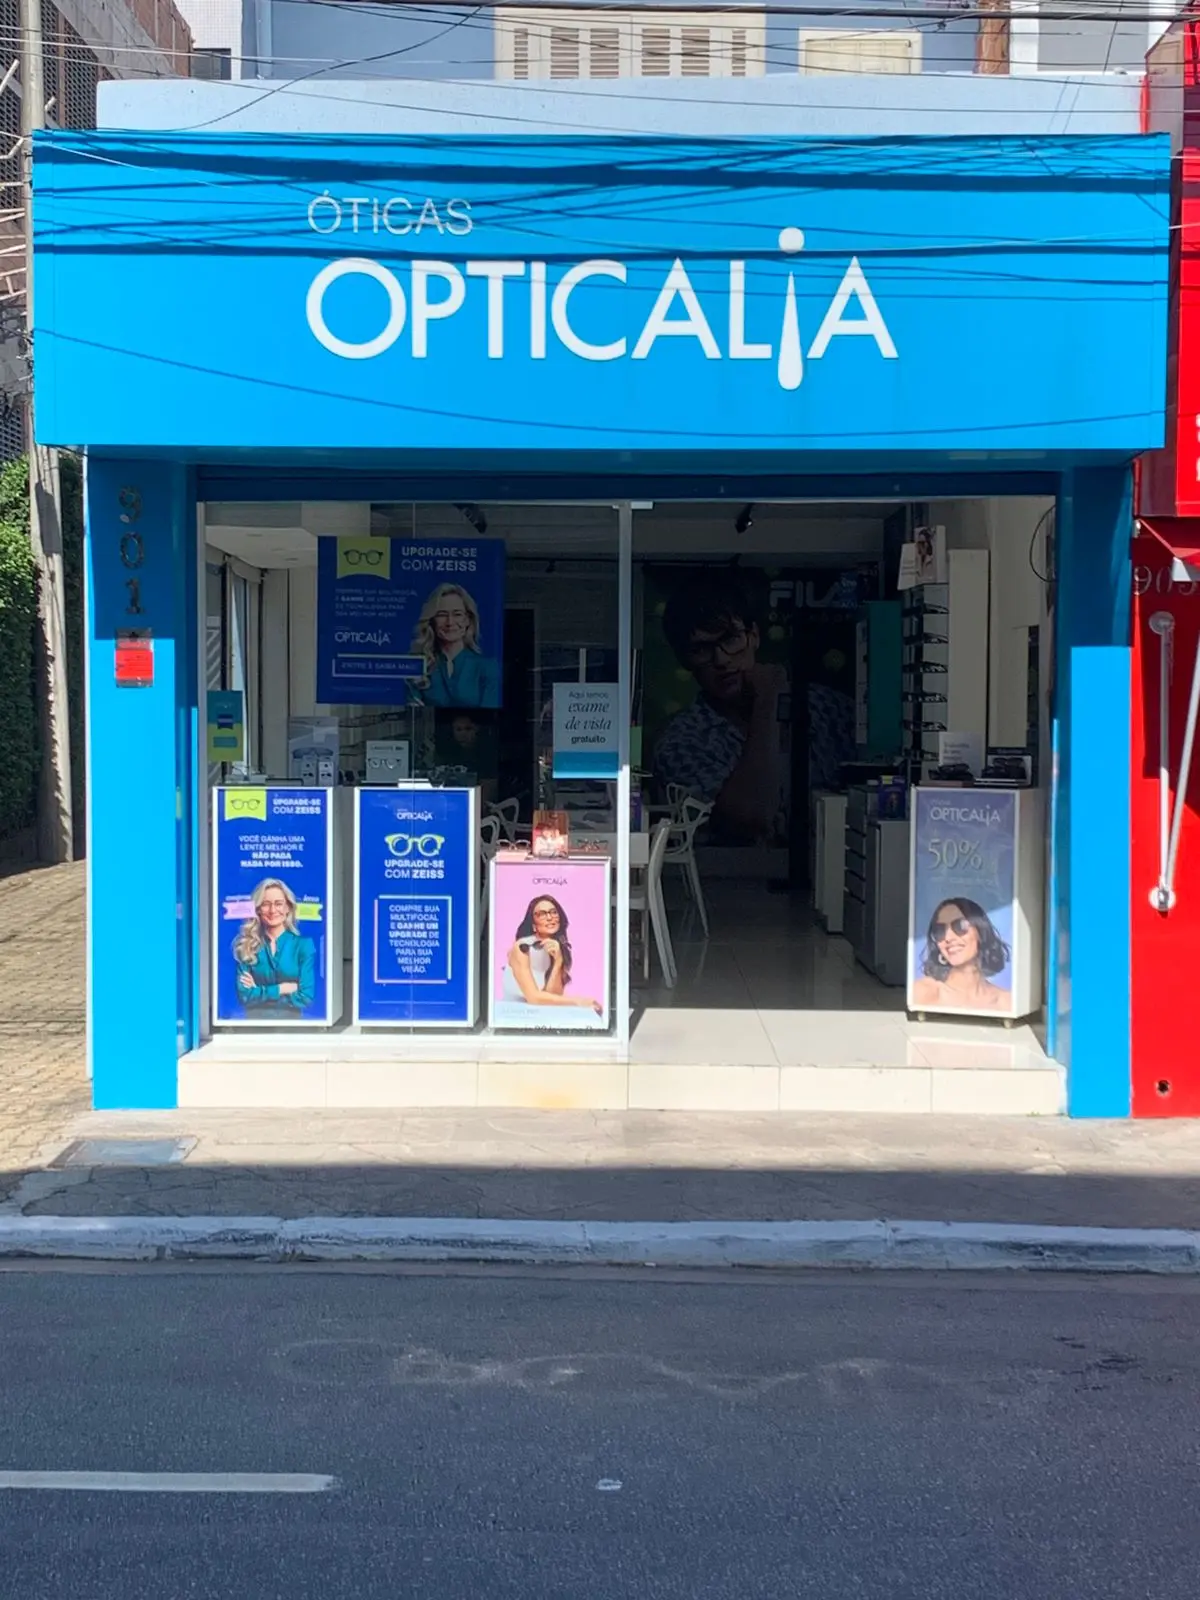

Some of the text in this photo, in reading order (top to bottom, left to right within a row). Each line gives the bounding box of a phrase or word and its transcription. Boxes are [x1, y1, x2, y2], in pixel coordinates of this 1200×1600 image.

[307, 190, 473, 236] ÓTICAS
[118, 485, 144, 615] 901
[401, 546, 478, 558] UPGRADE-SE
[401, 559, 477, 572] COM ZEISS
[568, 702, 610, 713] exame
[565, 716, 612, 731] de vista
[571, 735, 606, 745] gratuito
[272, 798, 321, 806] UPGRADE-SE
[273, 806, 321, 814] COM ZEISS
[239, 834, 305, 843] VOCÊ GANHA UMA
[239, 843, 264, 851] LENTE
[265, 843, 298, 851] MELHOR
[252, 851, 269, 859] NÃO
[927, 838, 984, 870] 50%
[384, 859, 445, 868] UPGRADE-SE
[385, 869, 445, 879] COM ZEISS
[389, 904, 440, 913] COMPRE SUA
[390, 913, 439, 921] MULTIFOCAL
[397, 922, 425, 930] GANHE
[426, 922, 438, 930] UM
[389, 931, 439, 939] UPGRADE DE
[389, 939, 440, 948] TECNOLOGIA
[395, 948, 433, 956] PARA SUA
[397, 957, 431, 965] MELHOR
